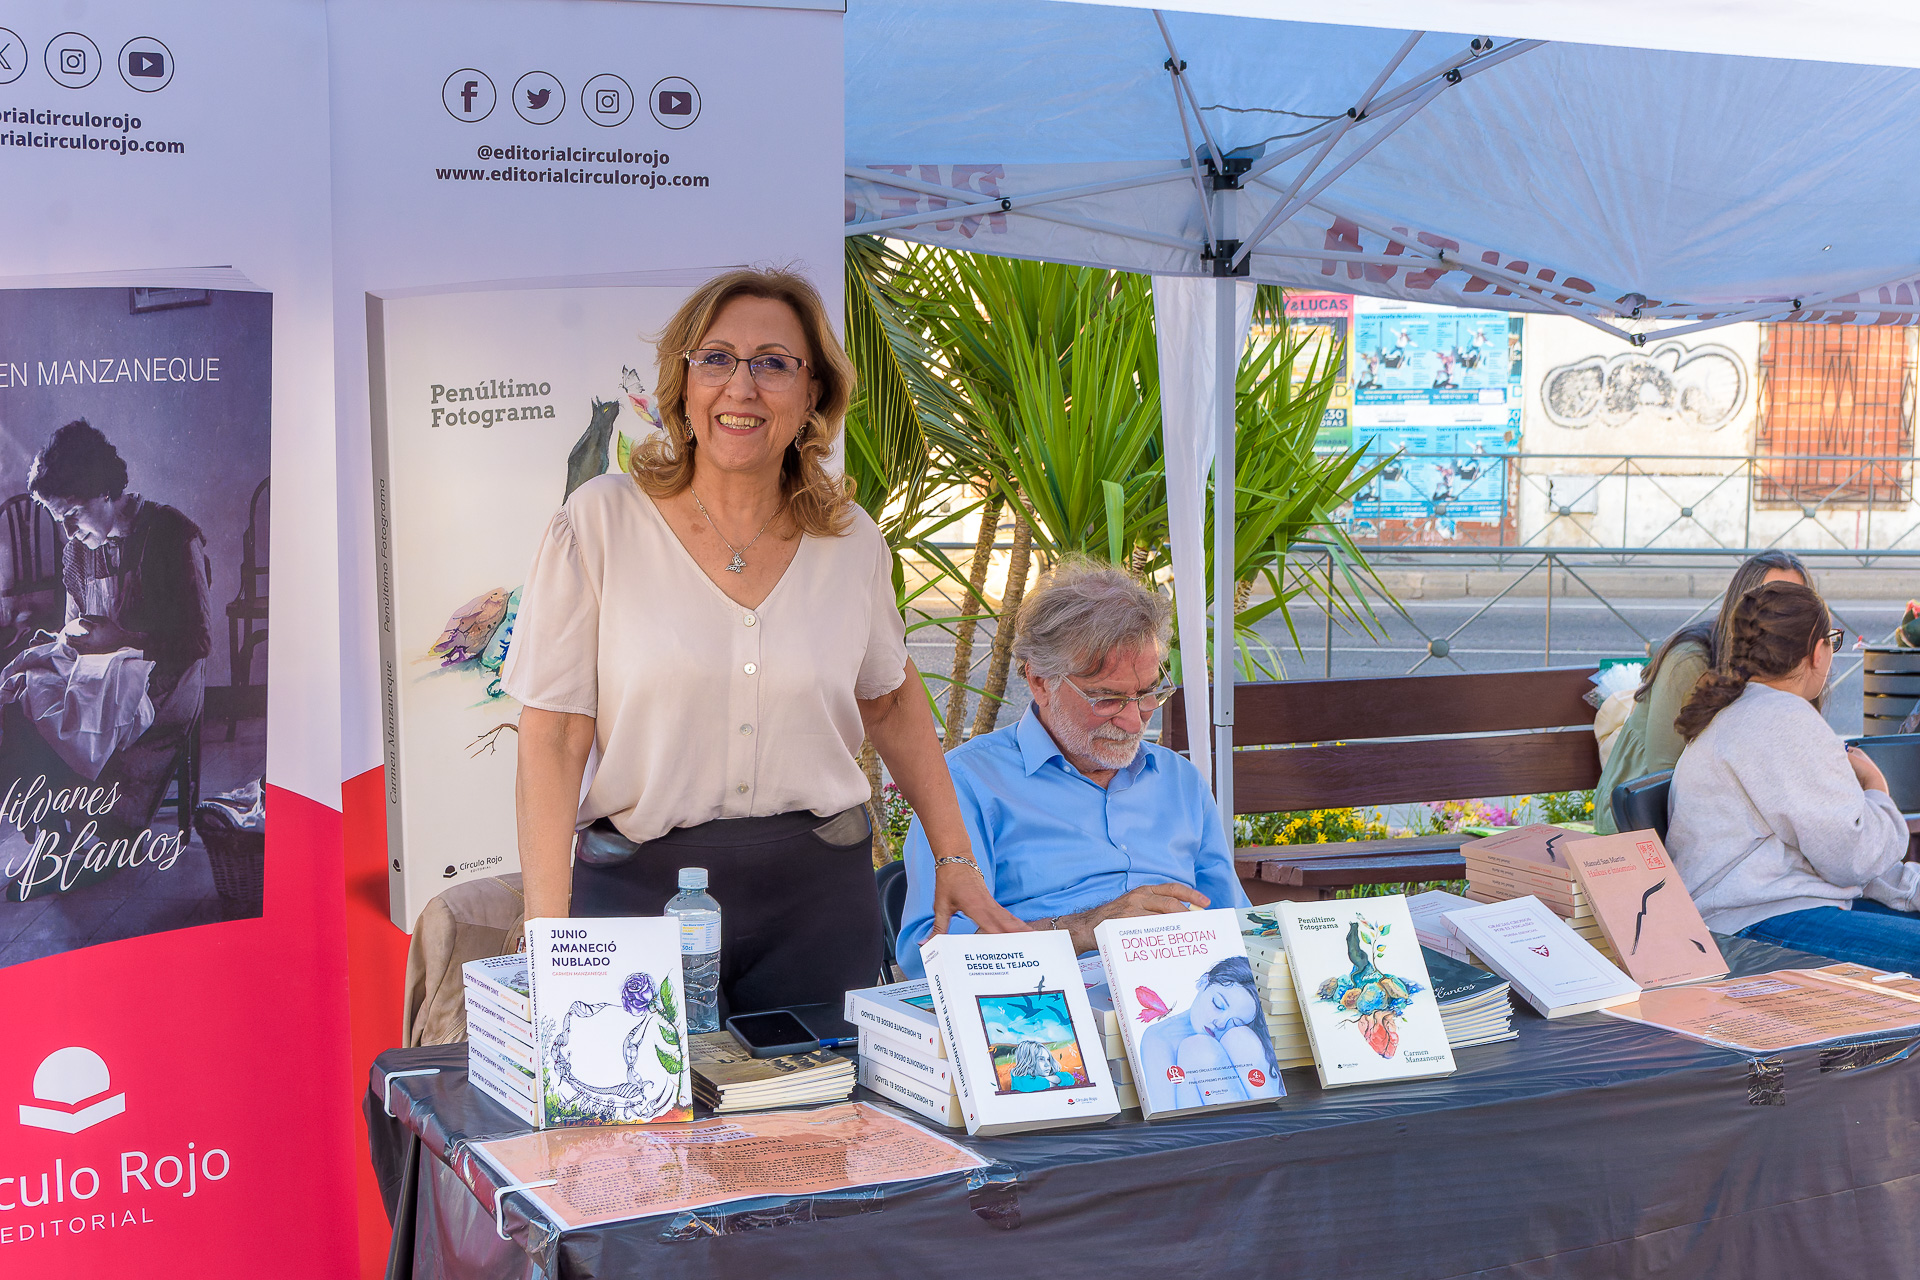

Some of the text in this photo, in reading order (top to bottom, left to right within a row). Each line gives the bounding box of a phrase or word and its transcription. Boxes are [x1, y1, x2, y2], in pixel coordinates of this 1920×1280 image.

[0, 107, 142, 133] rialcirculorojo
[477, 145, 670, 169] @editorialcirculorojo
[436, 166, 710, 189] www.editorialcirculorojo.com
[38, 357, 220, 386] MANZANEQUE
[430, 378, 552, 404] Penúltimo
[431, 404, 556, 429] Fotograma
[379, 478, 391, 633] Penúltimo Fotograma
[386, 660, 398, 805] Carmen Manzaneque
[5, 820, 187, 902] Blancos
[459, 854, 503, 872] Círculo Rojo
[1583, 859, 1601, 867] Manuel
[1587, 868, 1607, 878] Haikus
[1298, 916, 1336, 924] Penúltimo
[1300, 923, 1339, 931] Fotograma
[551, 929, 588, 939] JUNIO
[1119, 925, 1181, 936] CARMEN MANZANEQUE
[1121, 930, 1216, 949] DONDE BROTAN
[551, 940, 617, 953] AMANECIÓ
[1125, 944, 1209, 962] LAS VIOLETAS
[552, 956, 611, 967] NUBLADO
[965, 952, 1024, 961] EL HORIZONTE
[967, 962, 994, 970] DESDE
[1006, 960, 1040, 969] TEJADO
[934, 973, 968, 1097] EL HORIZONTE DESDE EL TEJADO
[1403, 1049, 1429, 1057] Carmen
[1406, 1054, 1445, 1063] Manzaneque
[0, 1141, 230, 1211] culo Rojo
[0, 1207, 154, 1244] EDITORIAL
